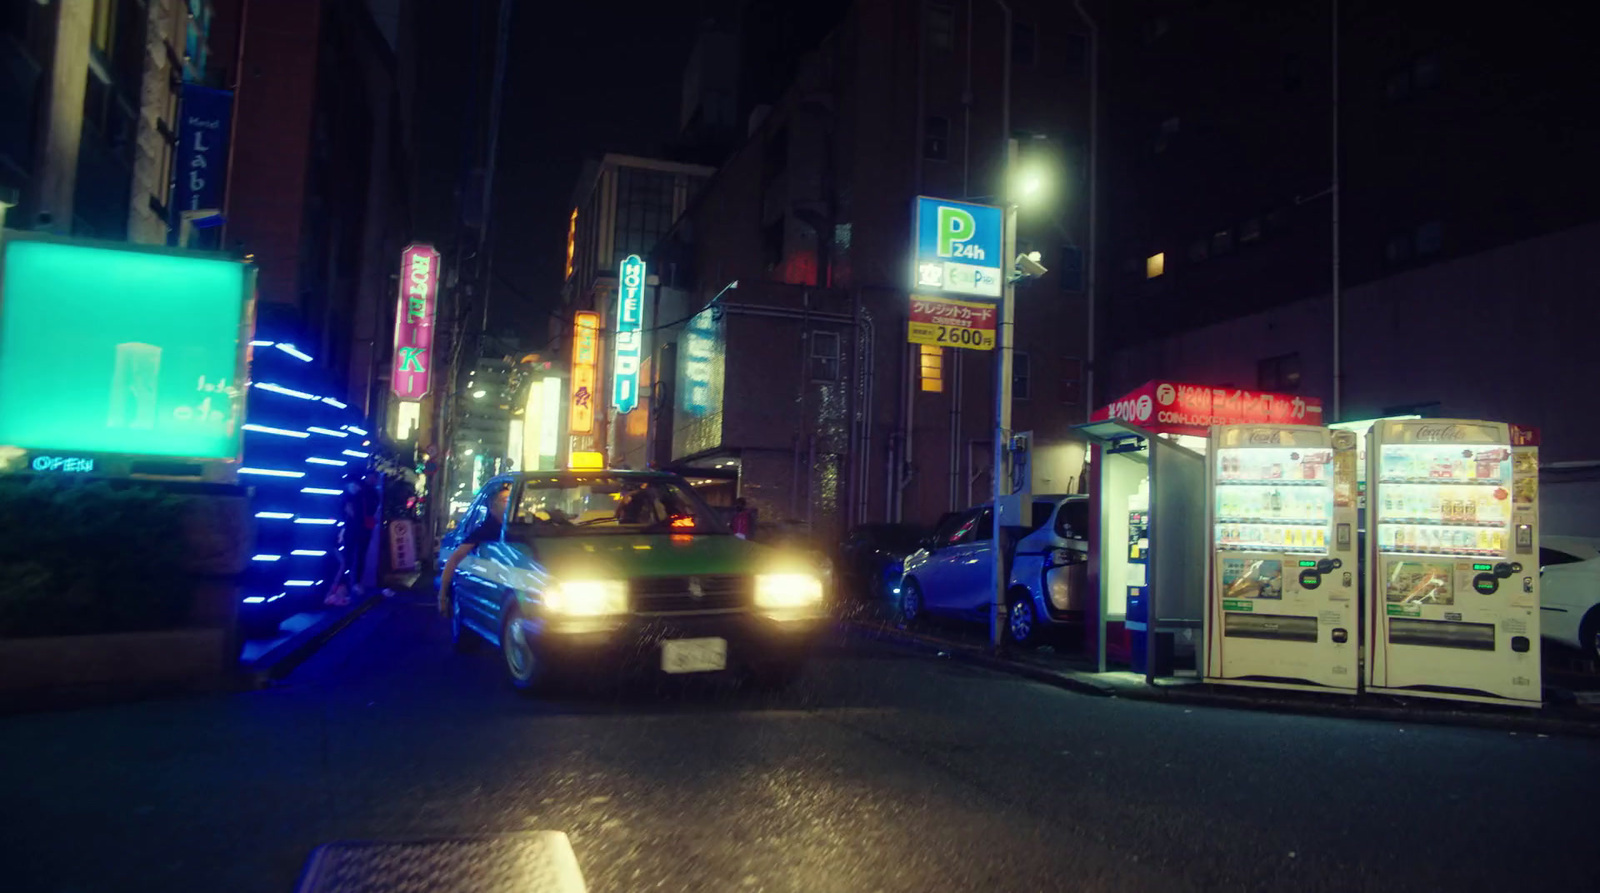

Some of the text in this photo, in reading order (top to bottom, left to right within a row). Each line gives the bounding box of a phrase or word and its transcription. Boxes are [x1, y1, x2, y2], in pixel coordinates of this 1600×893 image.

[937, 206, 976, 257] P
[953, 242, 985, 260] 24h
[407, 253, 431, 324] HOTEL
[622, 264, 640, 323] HOTEL
[913, 301, 992, 320] クレジットカード
